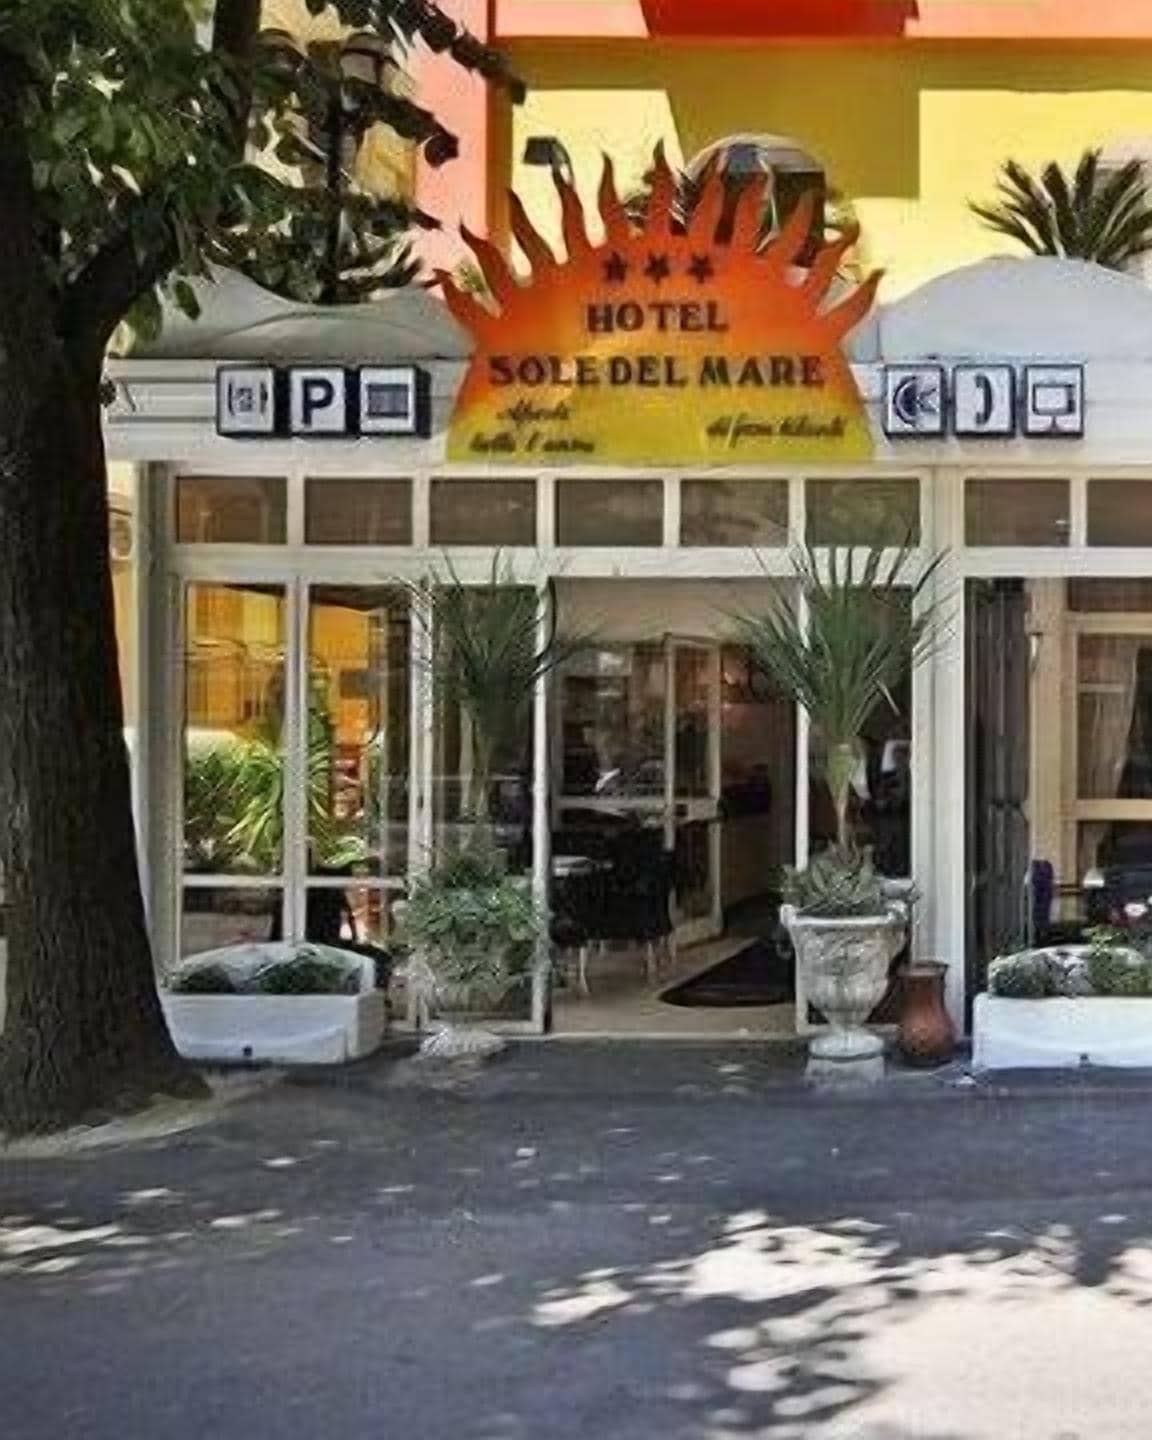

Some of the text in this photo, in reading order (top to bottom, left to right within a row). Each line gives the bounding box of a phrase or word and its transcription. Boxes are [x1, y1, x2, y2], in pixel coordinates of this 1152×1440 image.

[587, 301, 729, 333] HOTEL
[488, 356, 825, 388] SOLE DEL MARE
[302, 378, 335, 428] P
